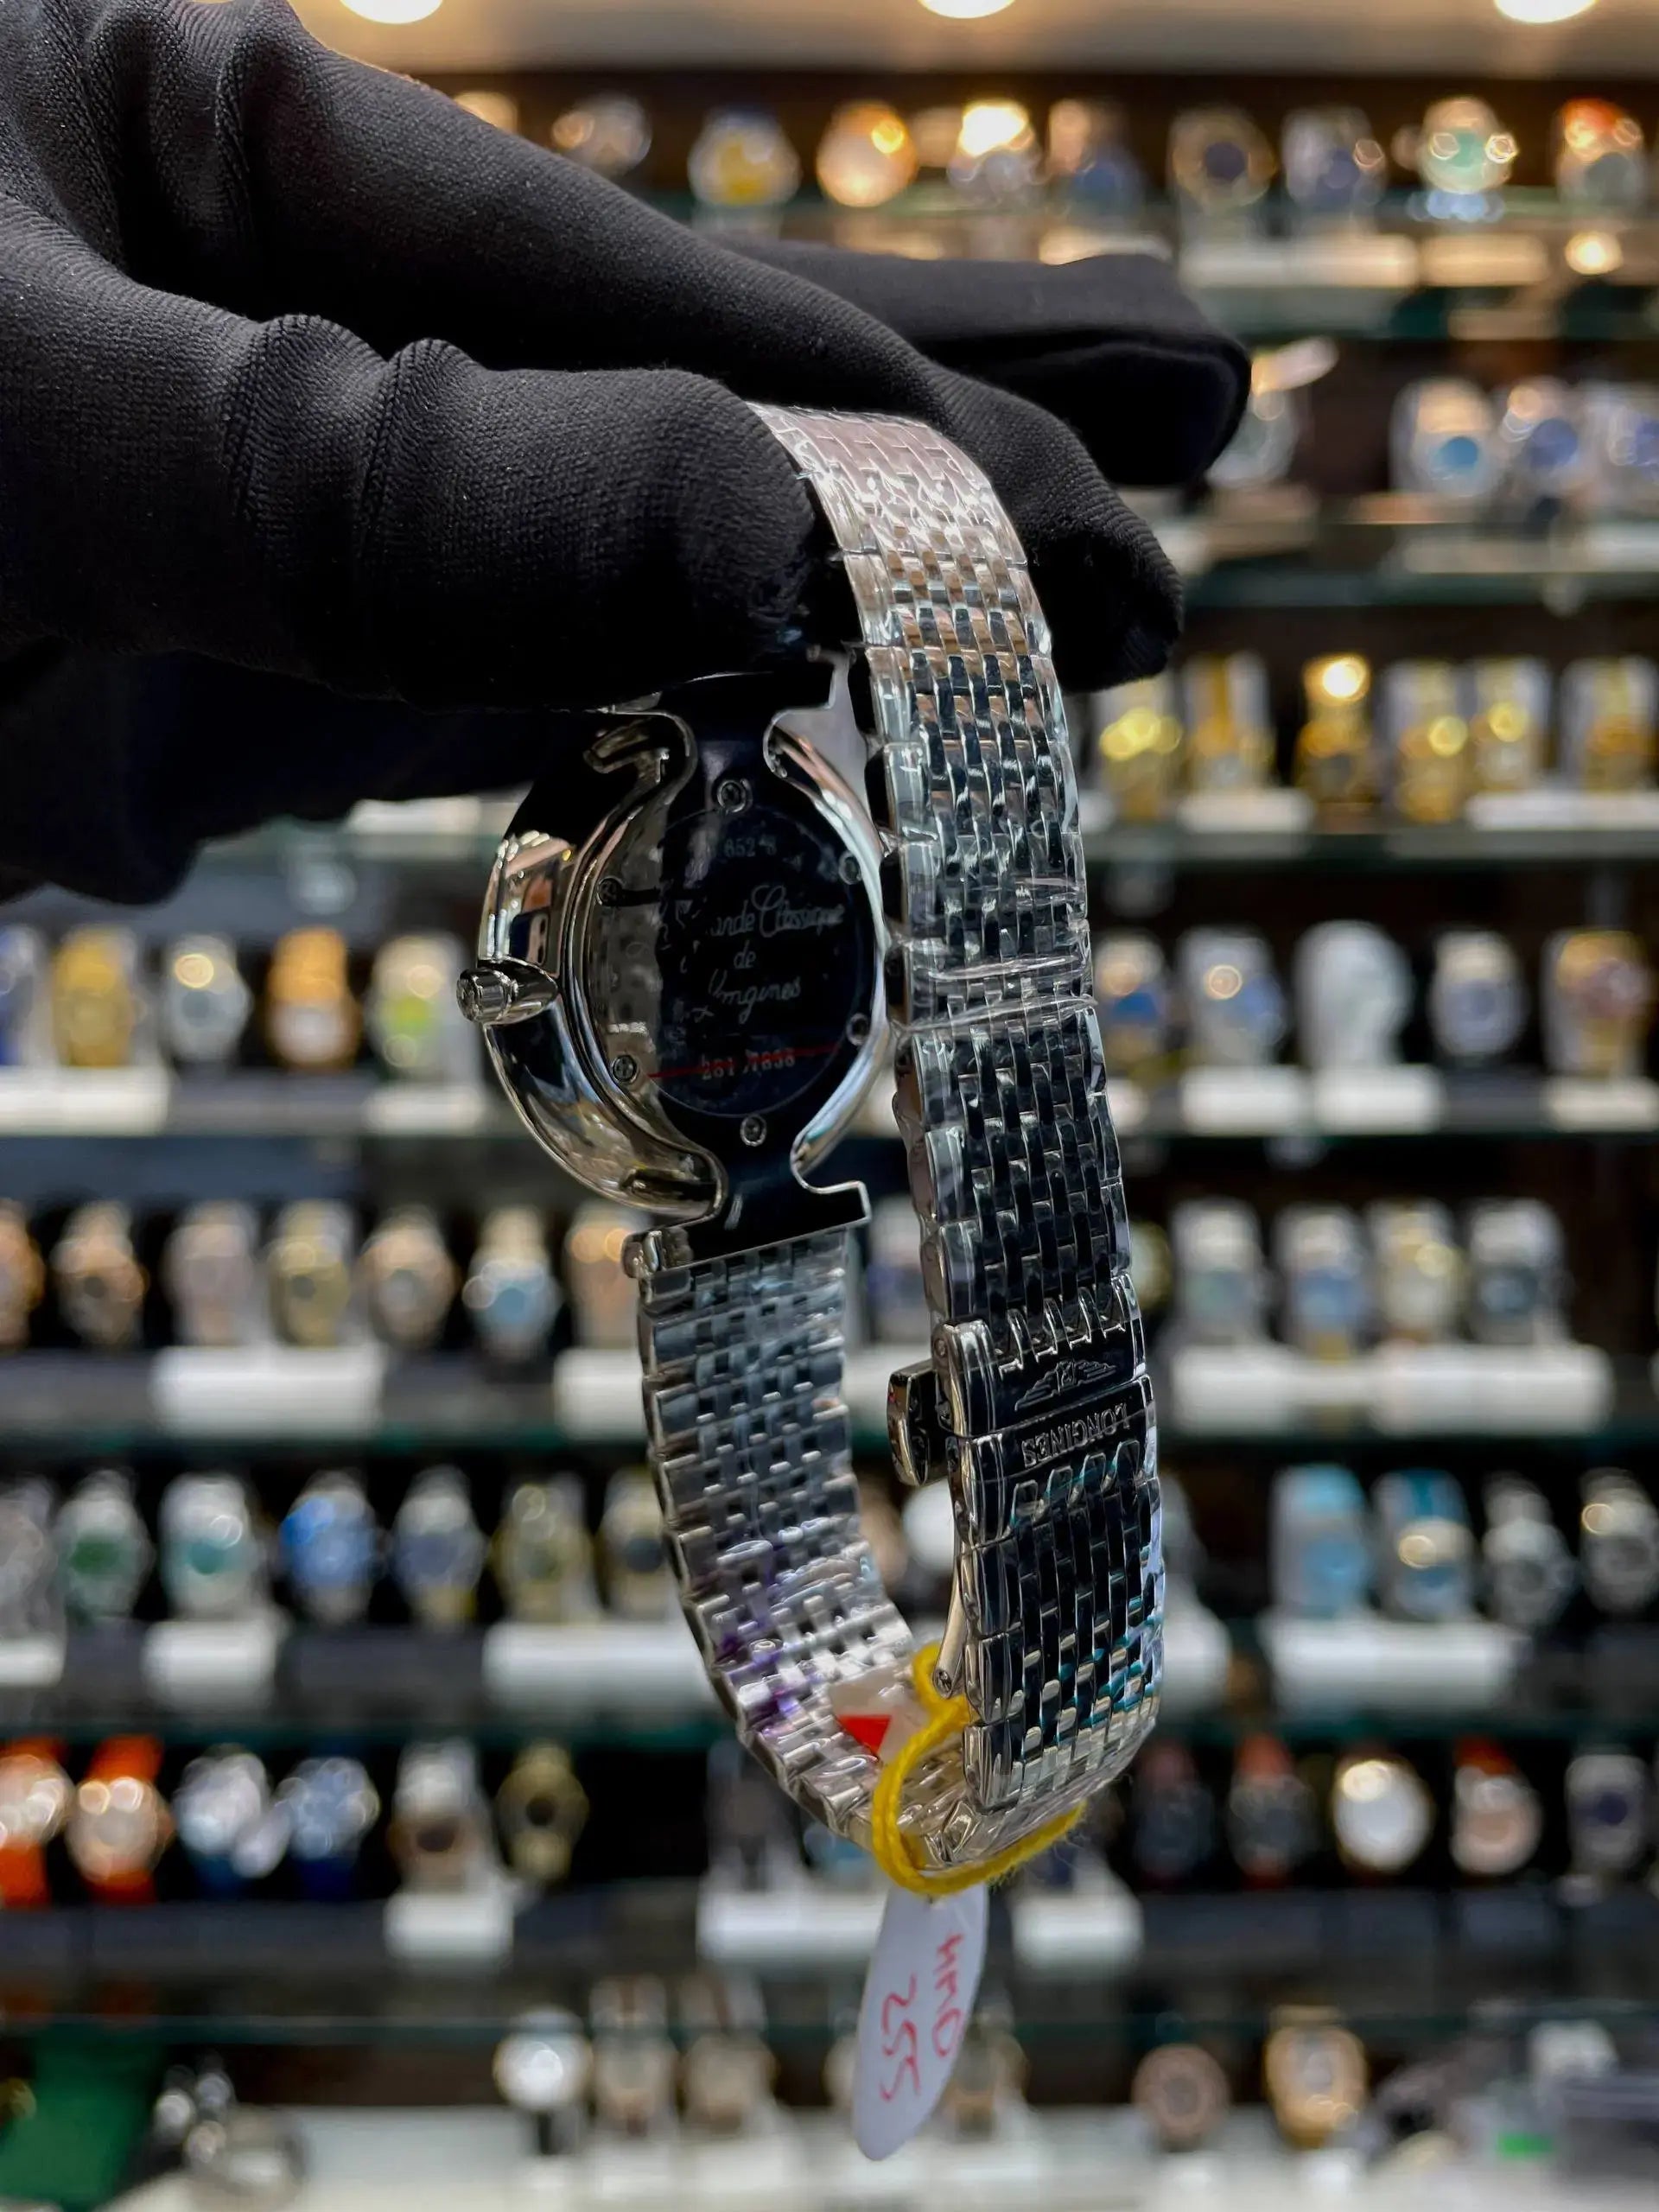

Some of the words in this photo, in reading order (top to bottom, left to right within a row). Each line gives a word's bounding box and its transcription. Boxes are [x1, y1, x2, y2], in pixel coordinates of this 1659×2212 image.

[734, 939, 756, 969] de
[1021, 1402, 1130, 1468] LONGINES
[880, 1972, 921, 2103] 255
